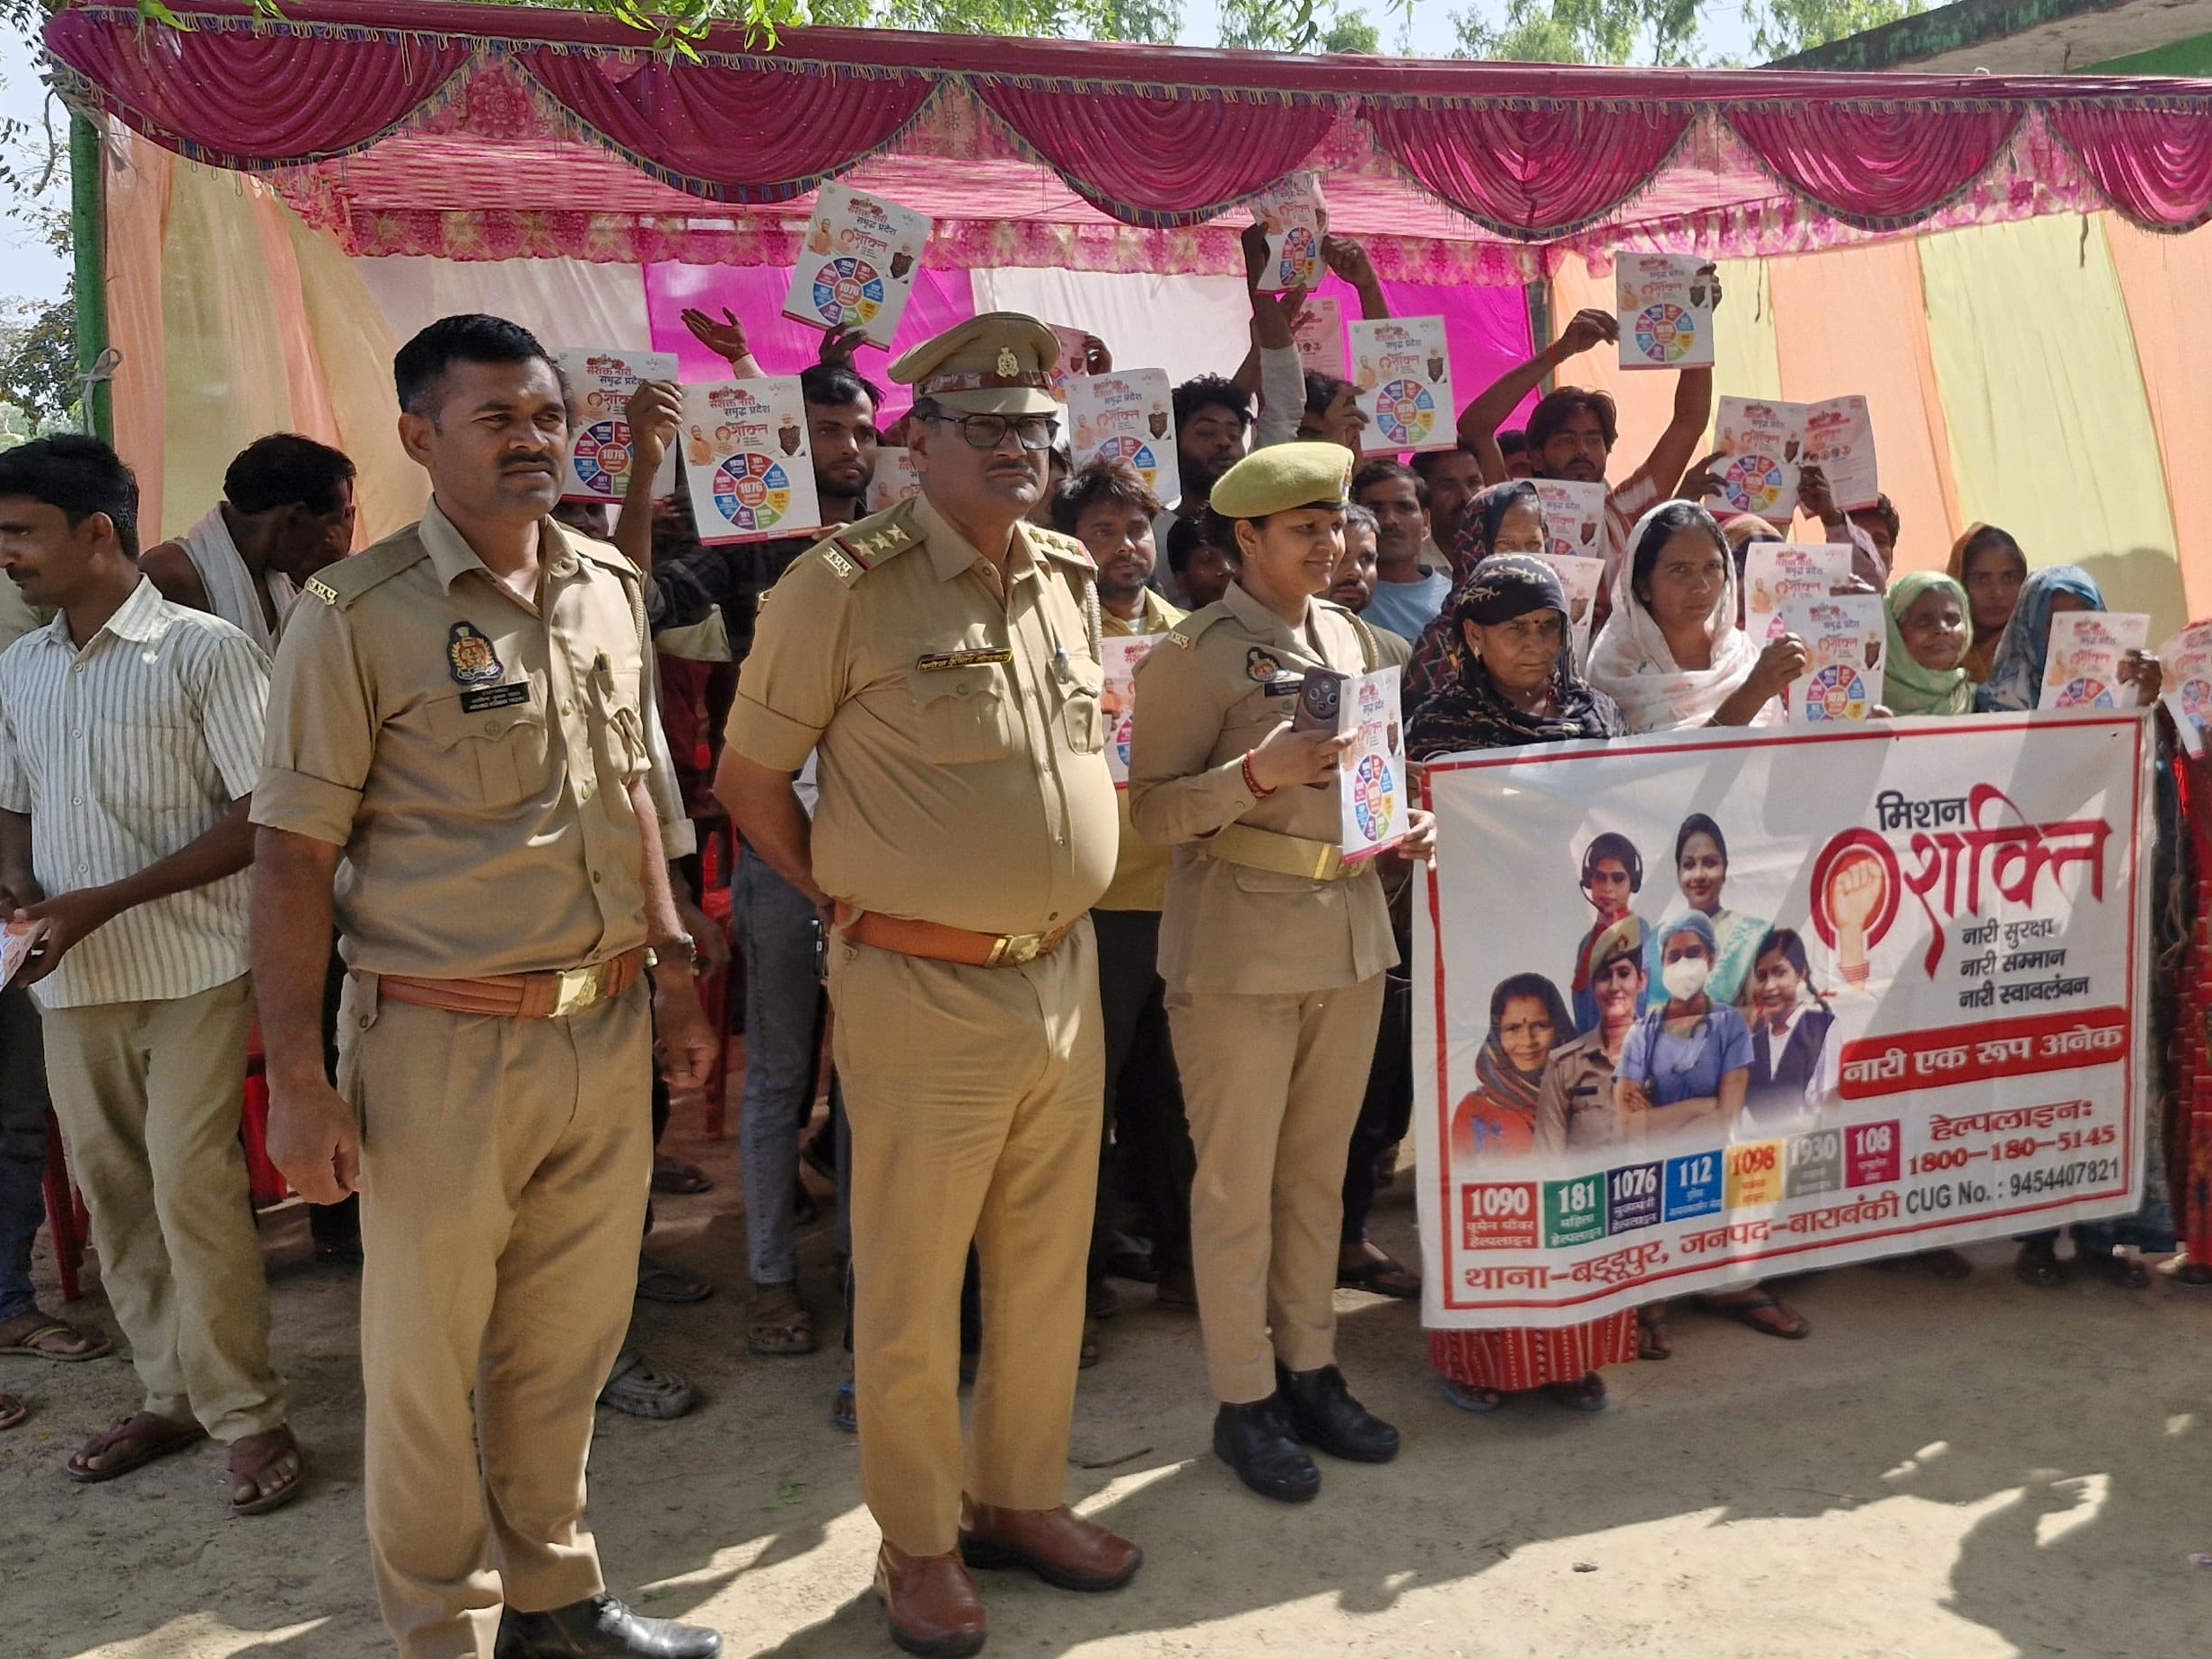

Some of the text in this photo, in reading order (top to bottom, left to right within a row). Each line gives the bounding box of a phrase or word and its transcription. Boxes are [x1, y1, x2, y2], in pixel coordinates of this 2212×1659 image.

[724, 404, 771, 418] समृद्ध प्रदेश
[1875, 789, 1968, 831] मिशन
[1903, 783, 2112, 980] शक्ति
[1962, 917, 2054, 949] नारी सुरक्षा
[1961, 948, 2067, 978] नारी सम्मान
[1959, 979, 1996, 1009] नारी
[1842, 1023, 2126, 1083] नारी एक रूप अनेक
[1788, 1133, 1838, 1166] 1930
[1855, 1126, 1892, 1156] 108
[1680, 1155, 1713, 1187] 112
[1732, 1145, 1776, 1177] 1098
[1558, 1180, 1596, 1214] 181
[1613, 1165, 1658, 1201] 1076
[1906, 1184, 1952, 1215] CUG
[2009, 1157, 2120, 1198] 9454407821
[1470, 1186, 1531, 1216] 1090
[1550, 1226, 1603, 1247] हेल्पलाइन
[1560, 1213, 1595, 1228] महिला
[1469, 1233, 1533, 1248] हेल्पलाइन
